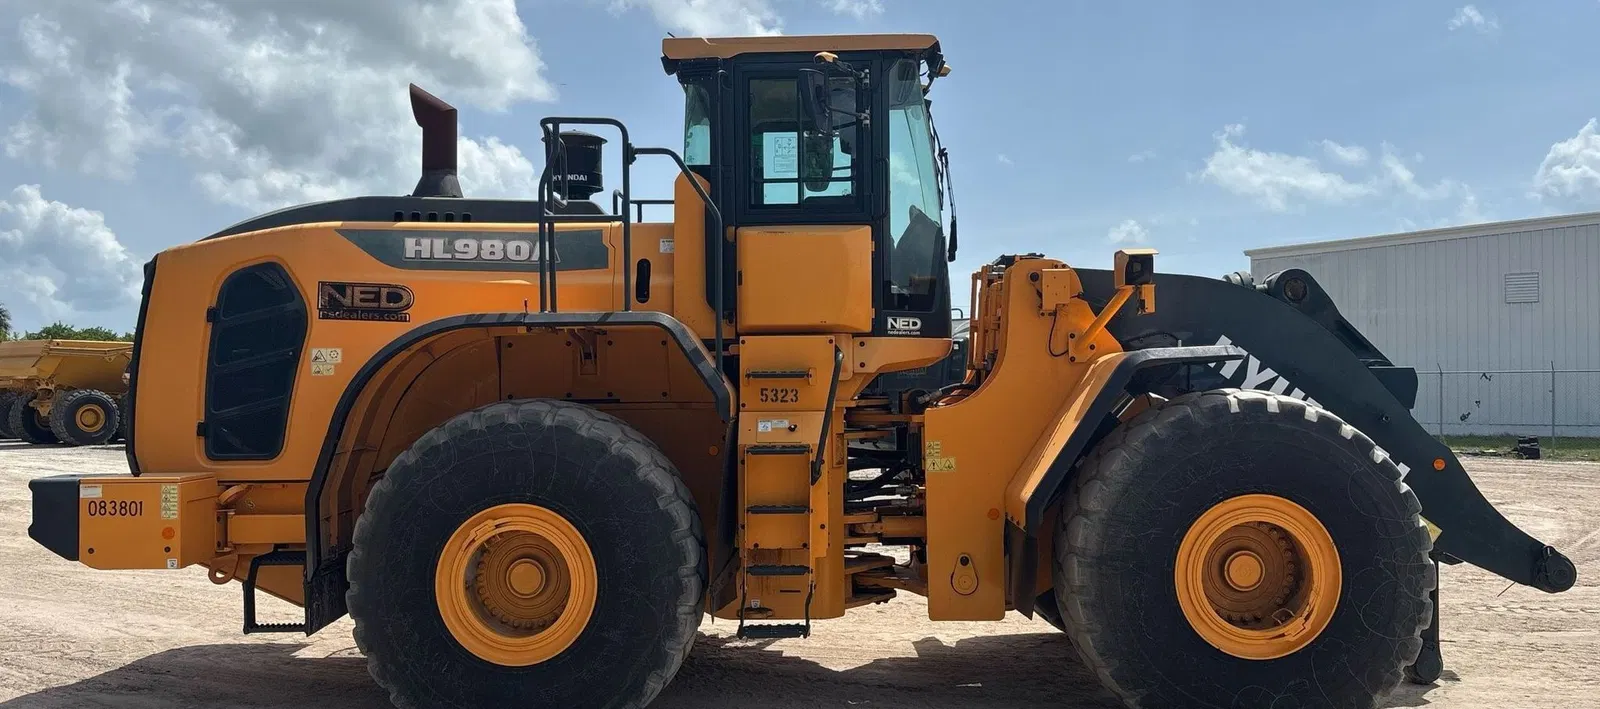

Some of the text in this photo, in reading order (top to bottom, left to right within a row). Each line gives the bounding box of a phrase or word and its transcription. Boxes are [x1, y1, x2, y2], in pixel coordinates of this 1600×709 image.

[320, 283, 413, 309] NED
[887, 317, 921, 330] NED
[760, 388, 799, 403] 5323
[88, 500, 143, 516] 083801
